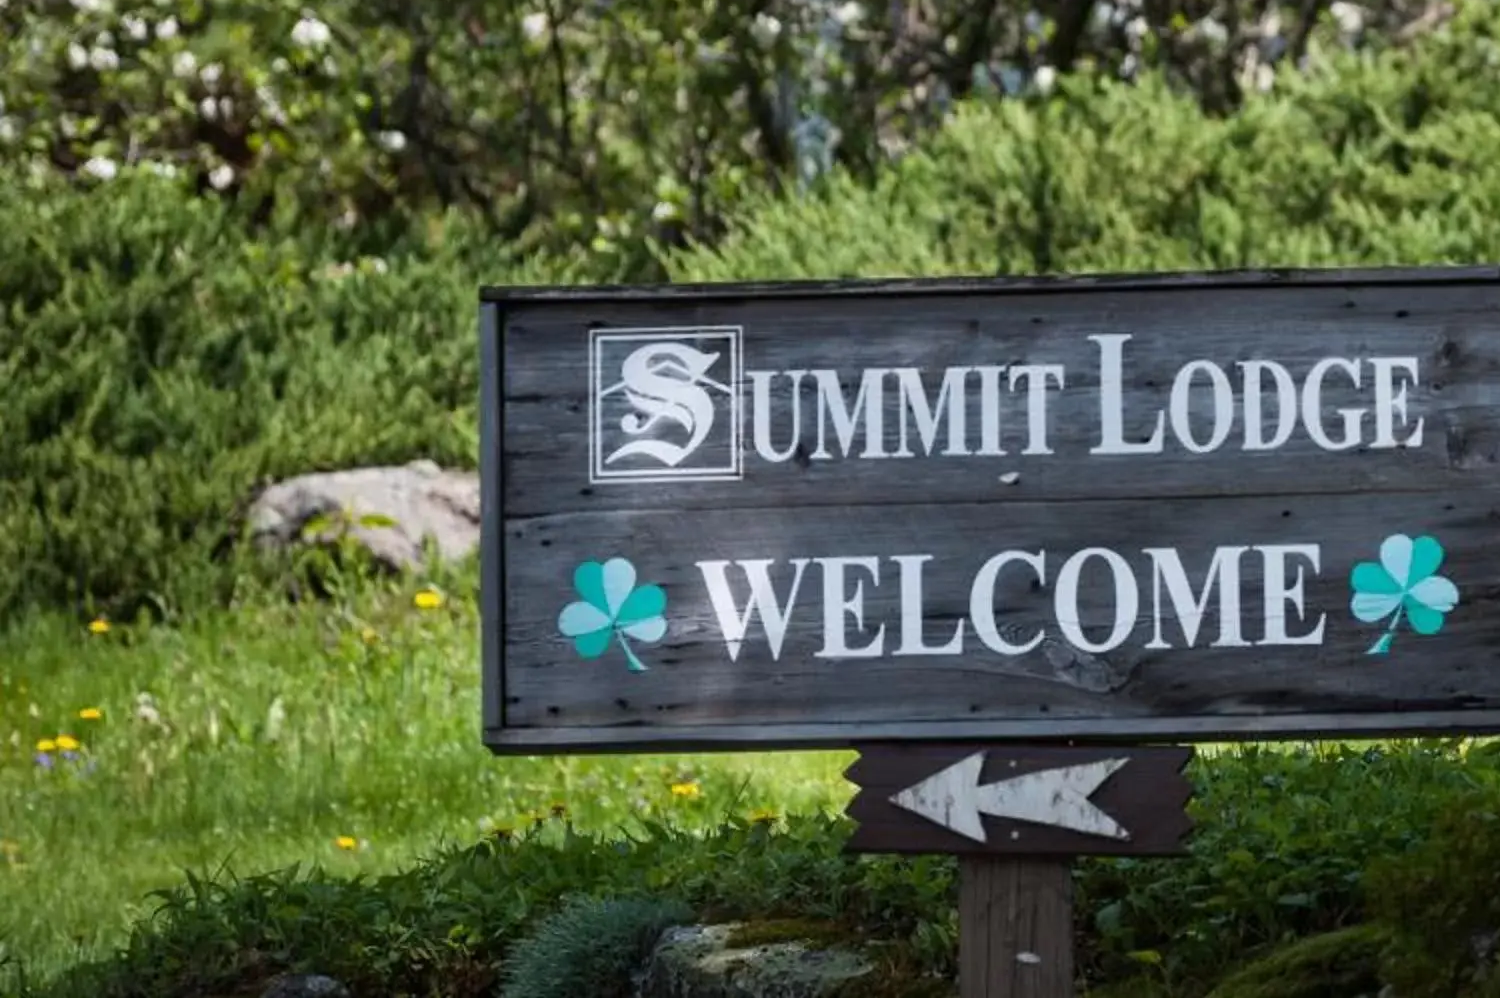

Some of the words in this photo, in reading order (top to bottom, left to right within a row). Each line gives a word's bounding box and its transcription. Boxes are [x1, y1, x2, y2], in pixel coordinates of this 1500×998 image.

[603, 340, 1065, 467] SUMMIT
[1087, 333, 1424, 454] LODGE
[694, 543, 1326, 662] WELCOME
